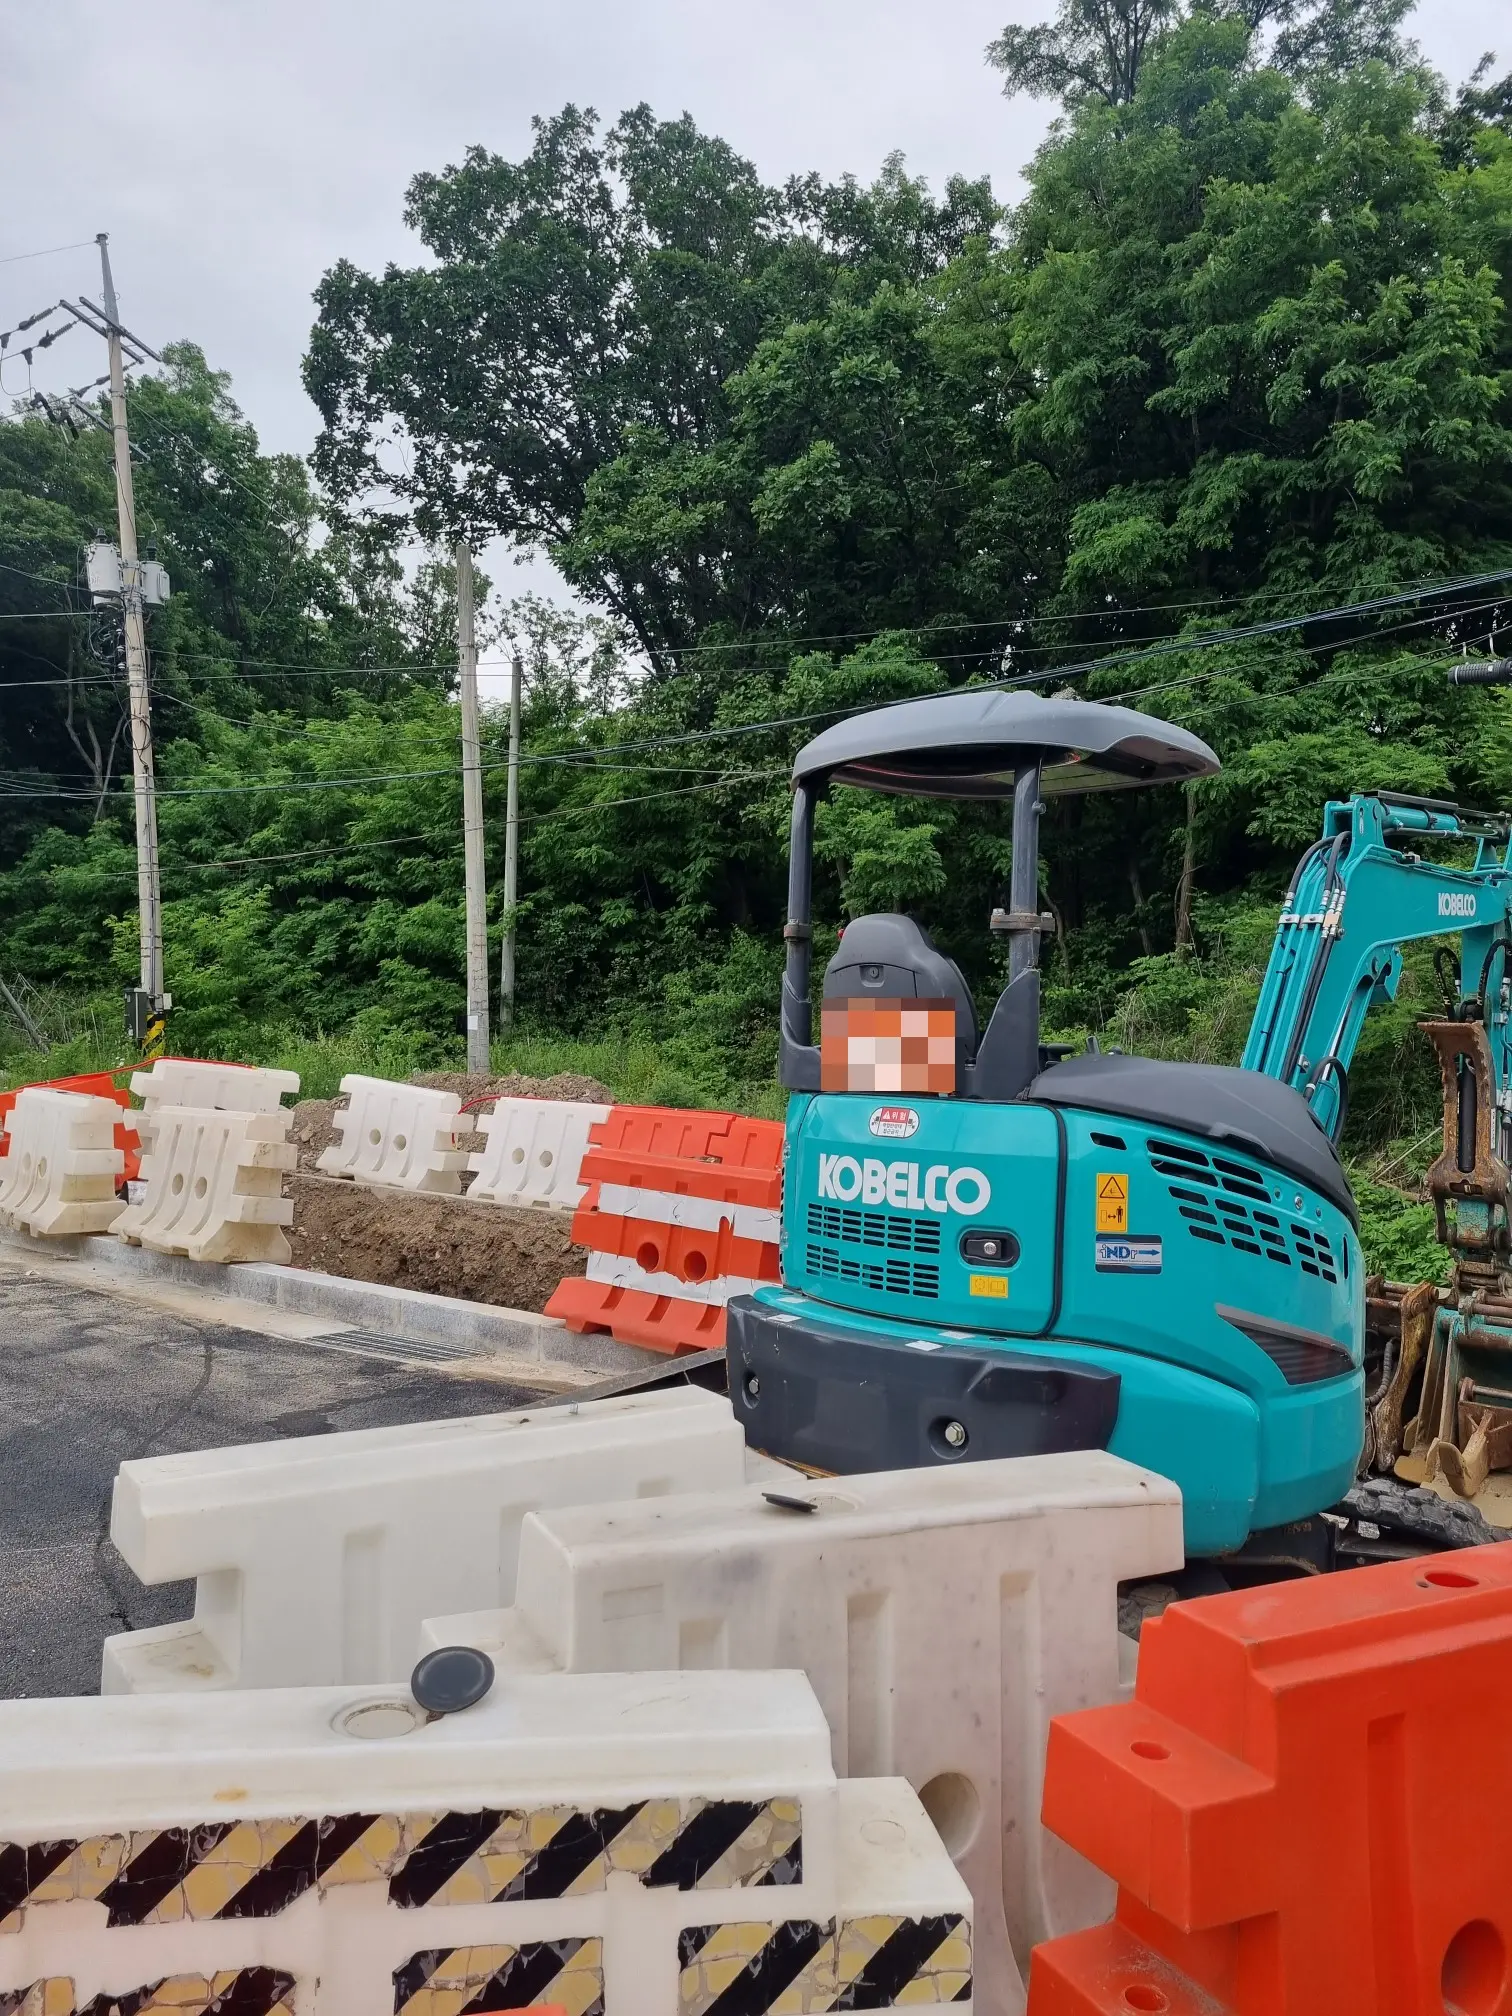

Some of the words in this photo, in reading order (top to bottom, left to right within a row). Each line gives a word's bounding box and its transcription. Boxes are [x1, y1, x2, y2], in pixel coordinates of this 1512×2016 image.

[1437, 892, 1476, 917] KOBELCO
[892, 1111, 906, 1120] 위험
[818, 1153, 991, 1216] KOBELCO
